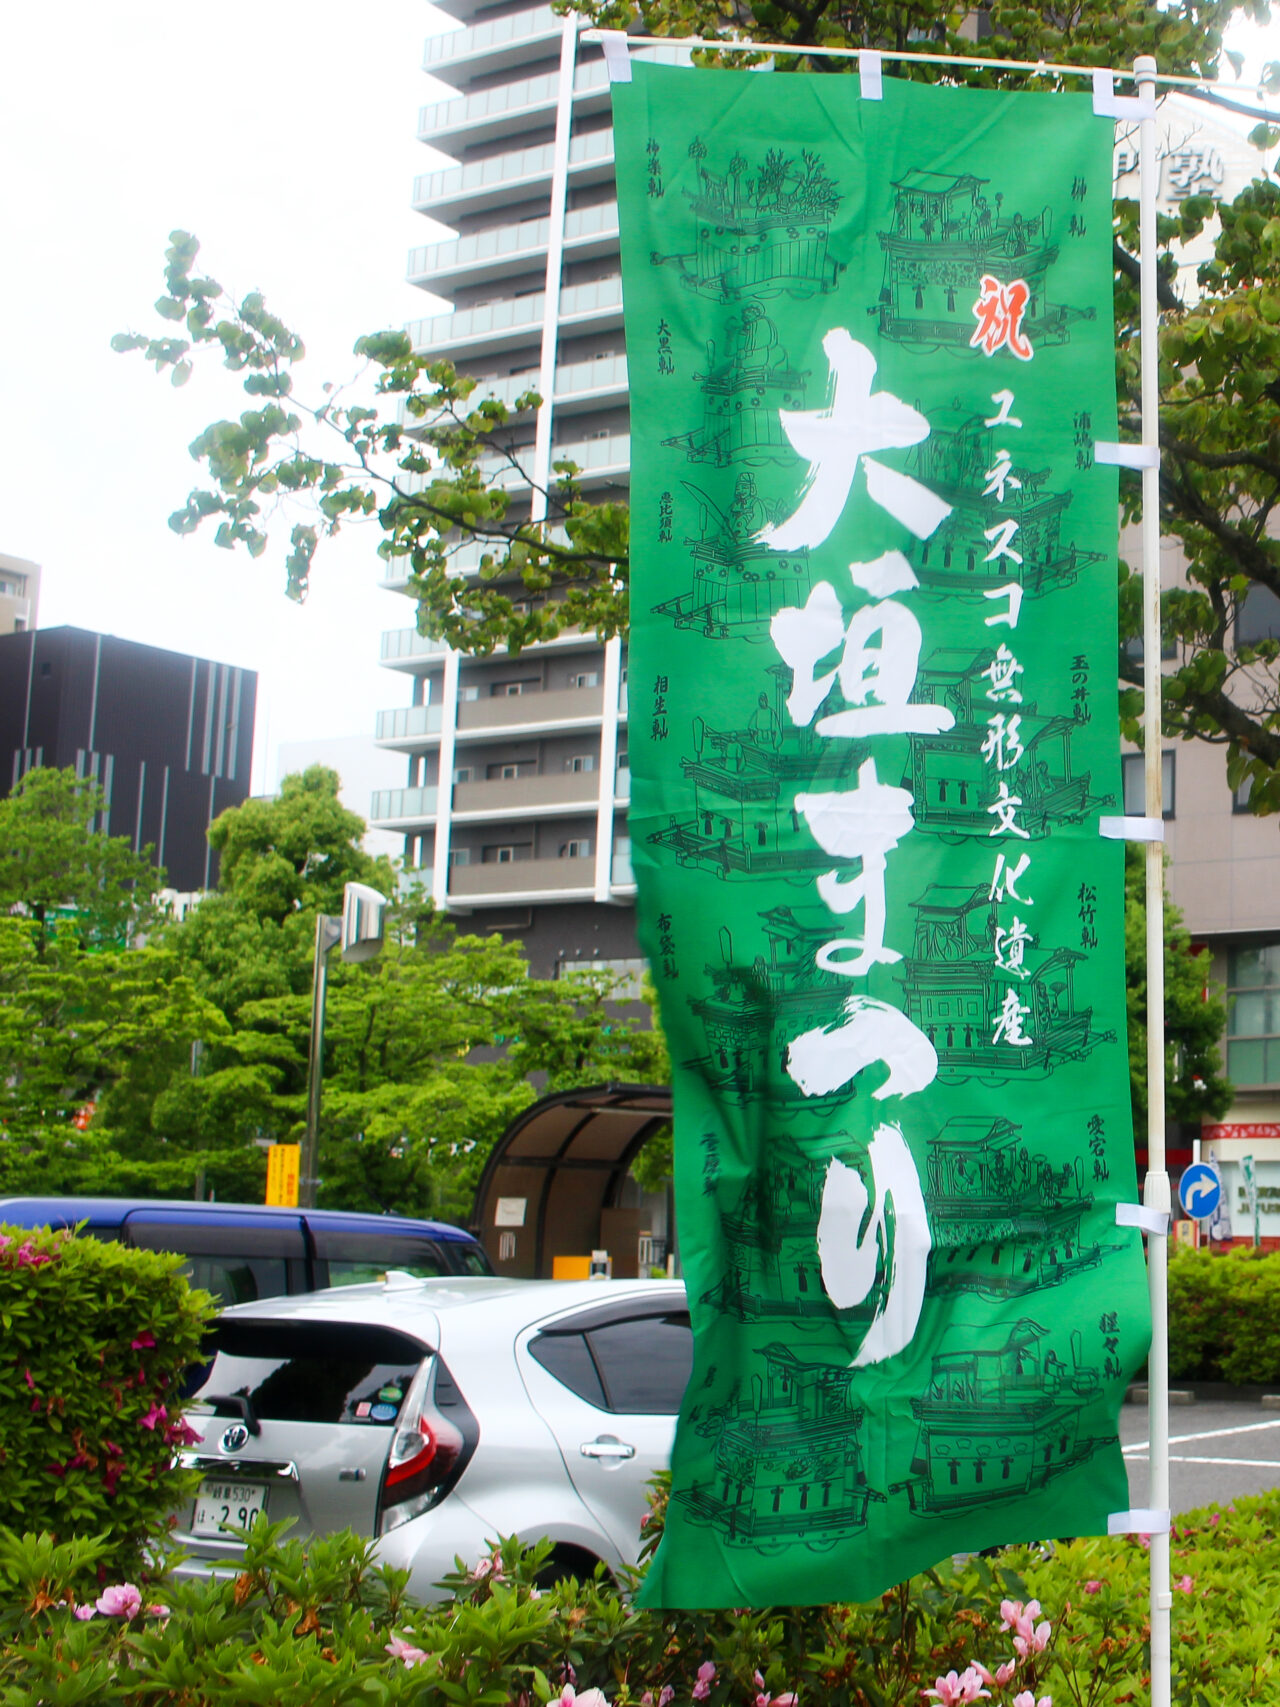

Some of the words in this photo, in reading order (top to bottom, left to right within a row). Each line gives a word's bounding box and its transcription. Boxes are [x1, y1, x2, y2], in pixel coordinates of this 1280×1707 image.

[969, 274, 1035, 362] 祝
[749, 326, 956, 1368] 大垣まつり
[980, 389, 1035, 1047] ユネスコ無形文化遺産
